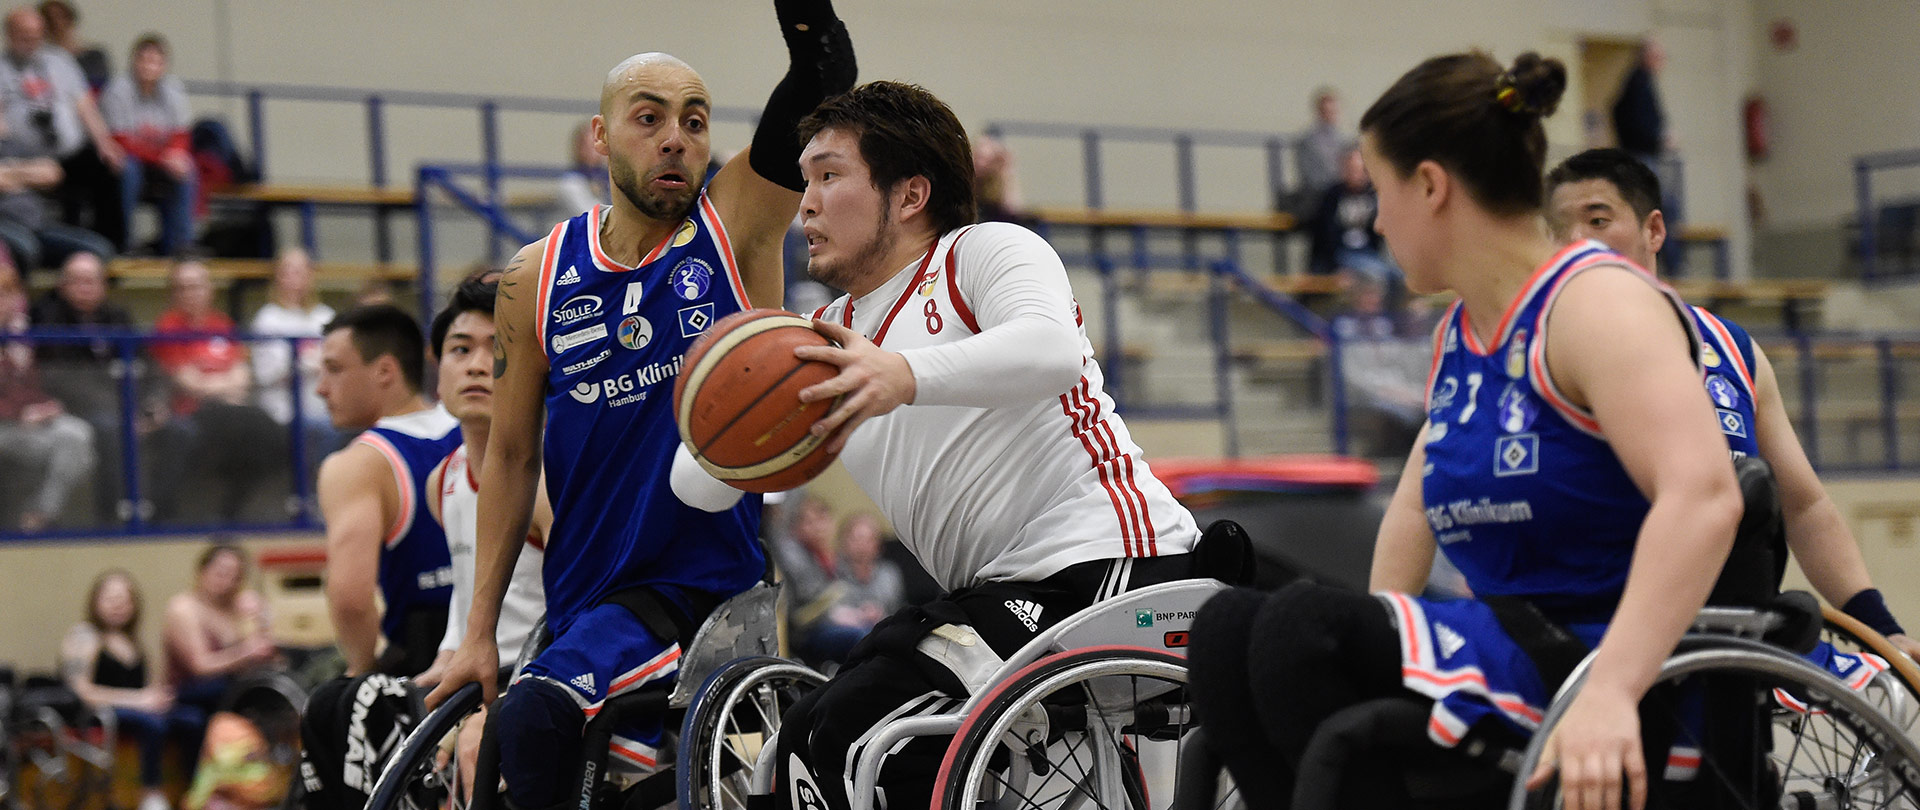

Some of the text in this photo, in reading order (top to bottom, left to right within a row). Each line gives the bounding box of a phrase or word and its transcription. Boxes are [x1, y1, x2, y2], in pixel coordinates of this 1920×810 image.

[556, 276, 582, 286] adidas
[622, 281, 643, 316] 4
[552, 303, 592, 324] STOLLE
[923, 298, 943, 335] 8
[603, 374, 635, 399] BG
[1458, 372, 1483, 424] 7
[1004, 600, 1038, 633] adidas
[1156, 612, 1175, 621] BNP
[570, 678, 598, 696] adidas
